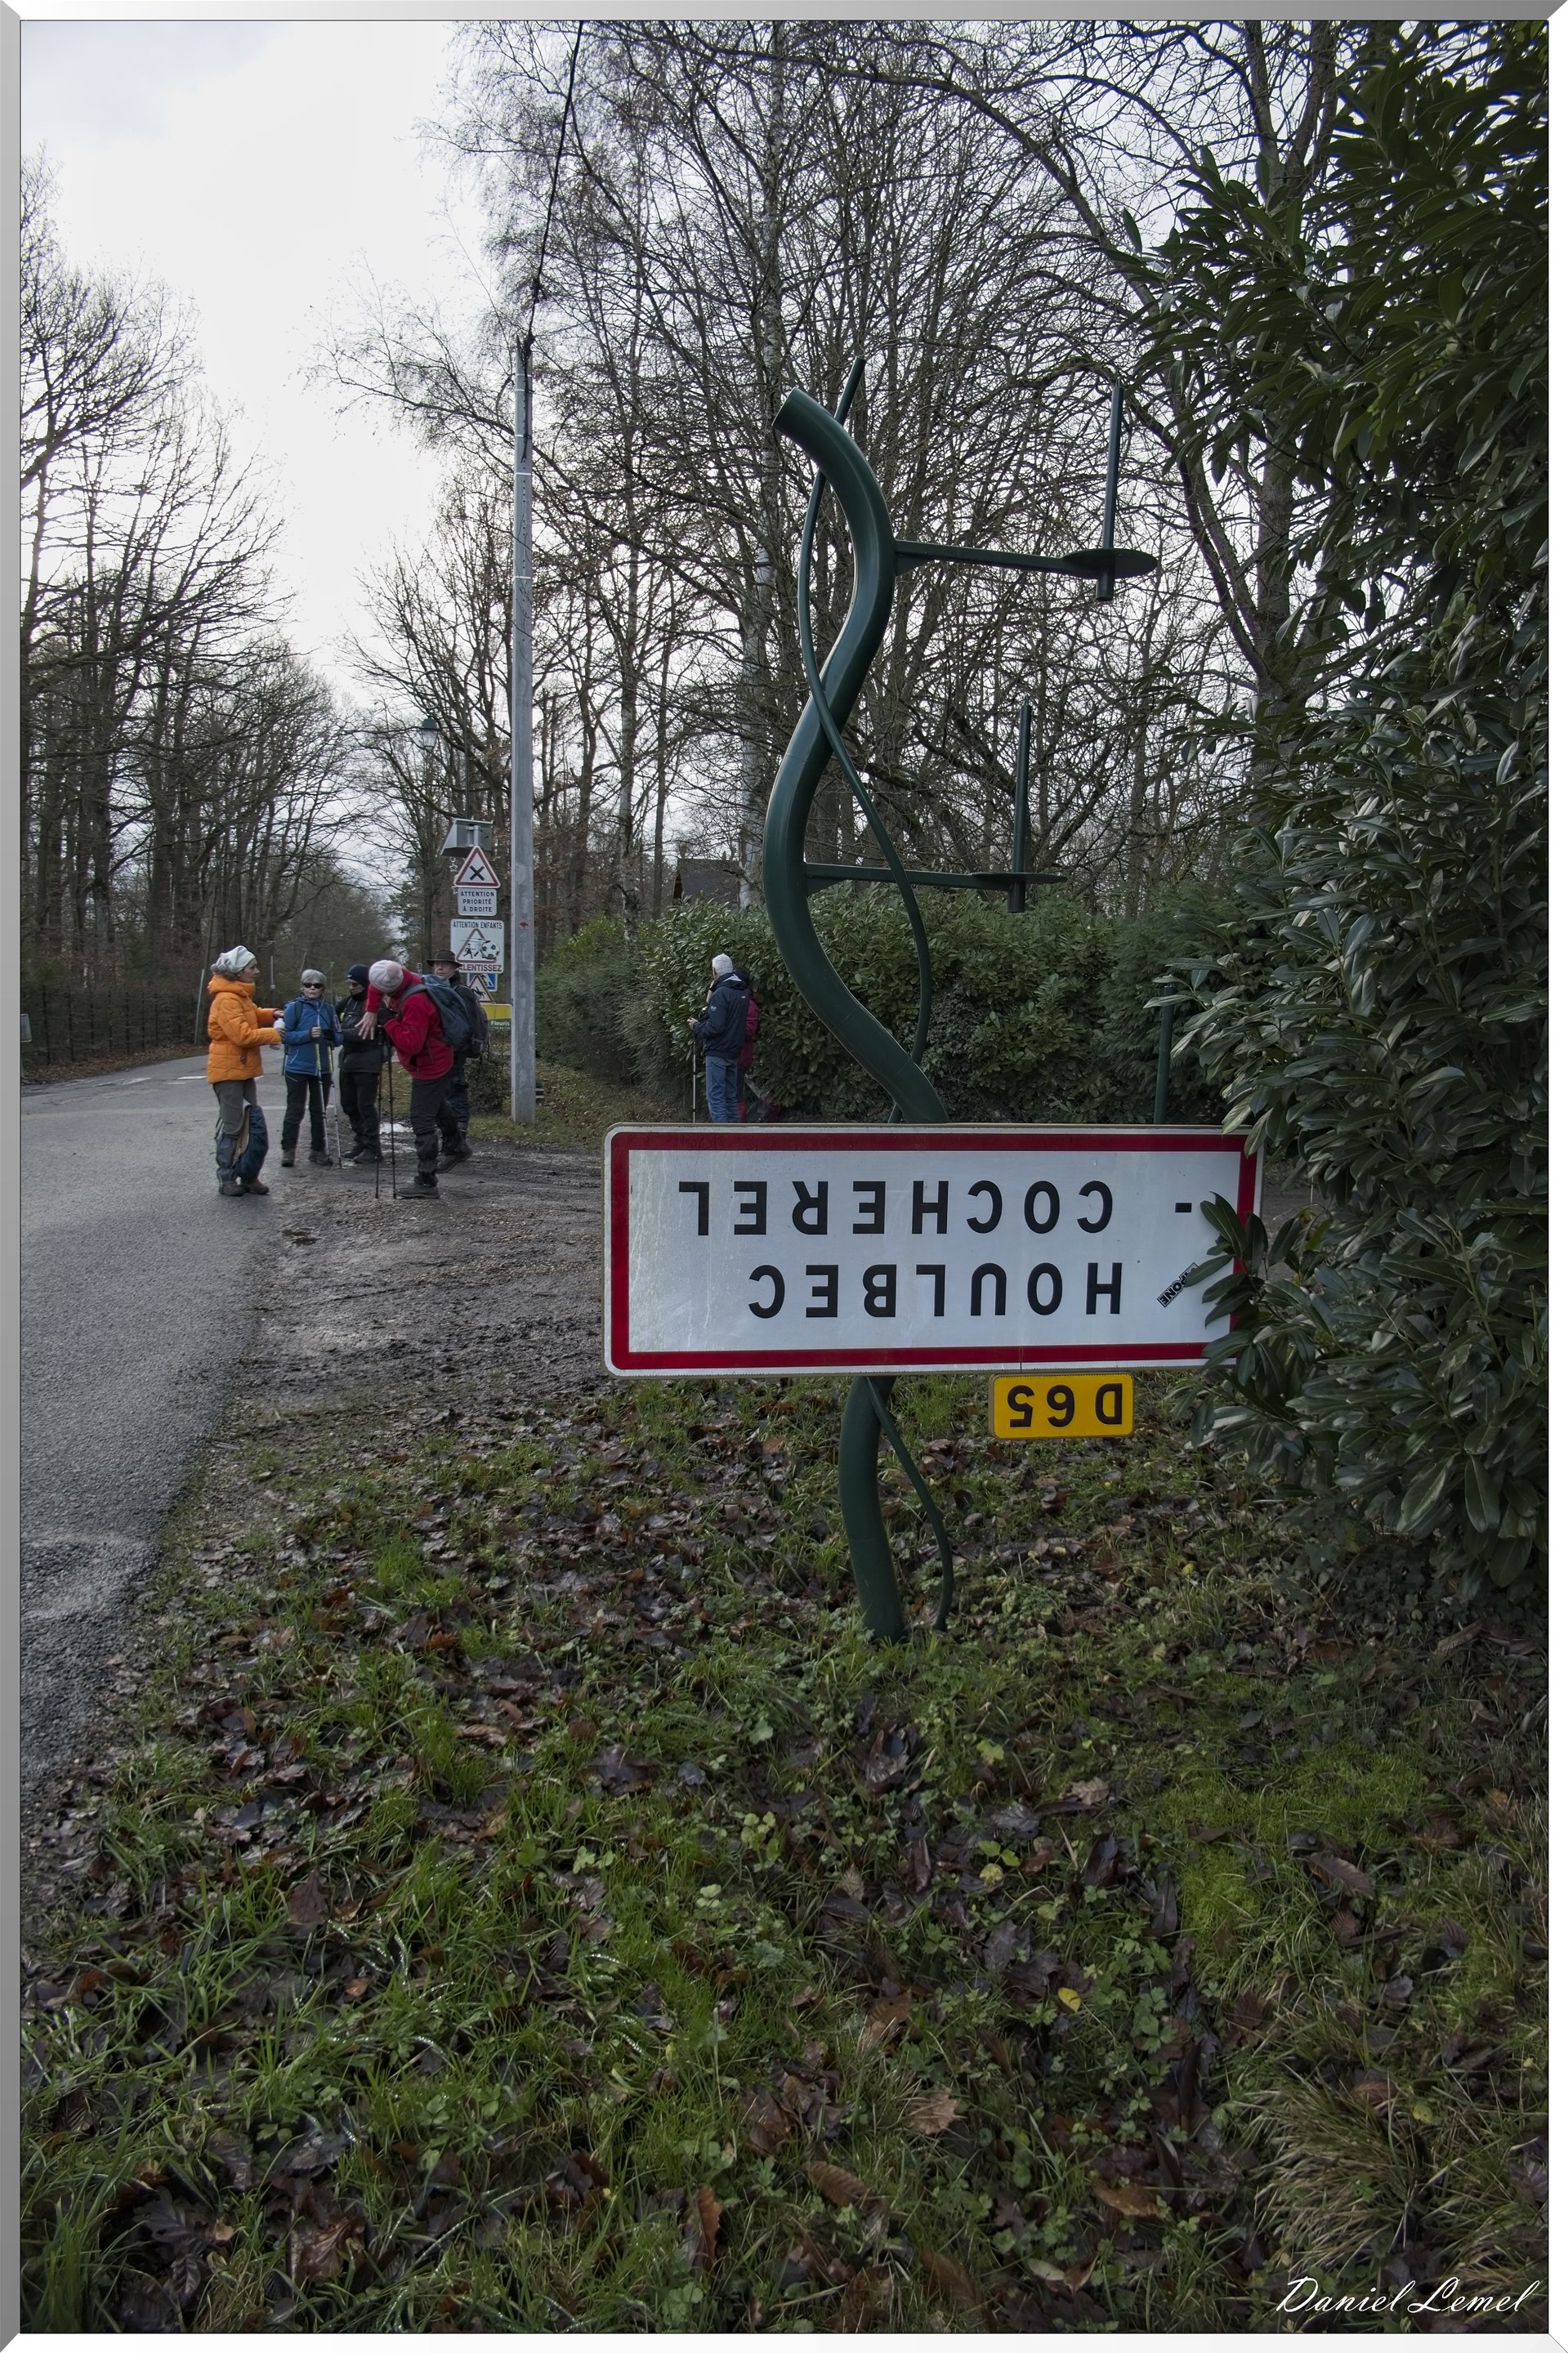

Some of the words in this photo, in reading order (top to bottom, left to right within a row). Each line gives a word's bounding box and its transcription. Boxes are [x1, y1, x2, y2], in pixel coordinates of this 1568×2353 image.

[458, 964, 503, 972] ALENTISSEZ
[678, 1180, 1113, 1236] COCHEREL
[748, 1262, 1123, 1319] HOULBEC
